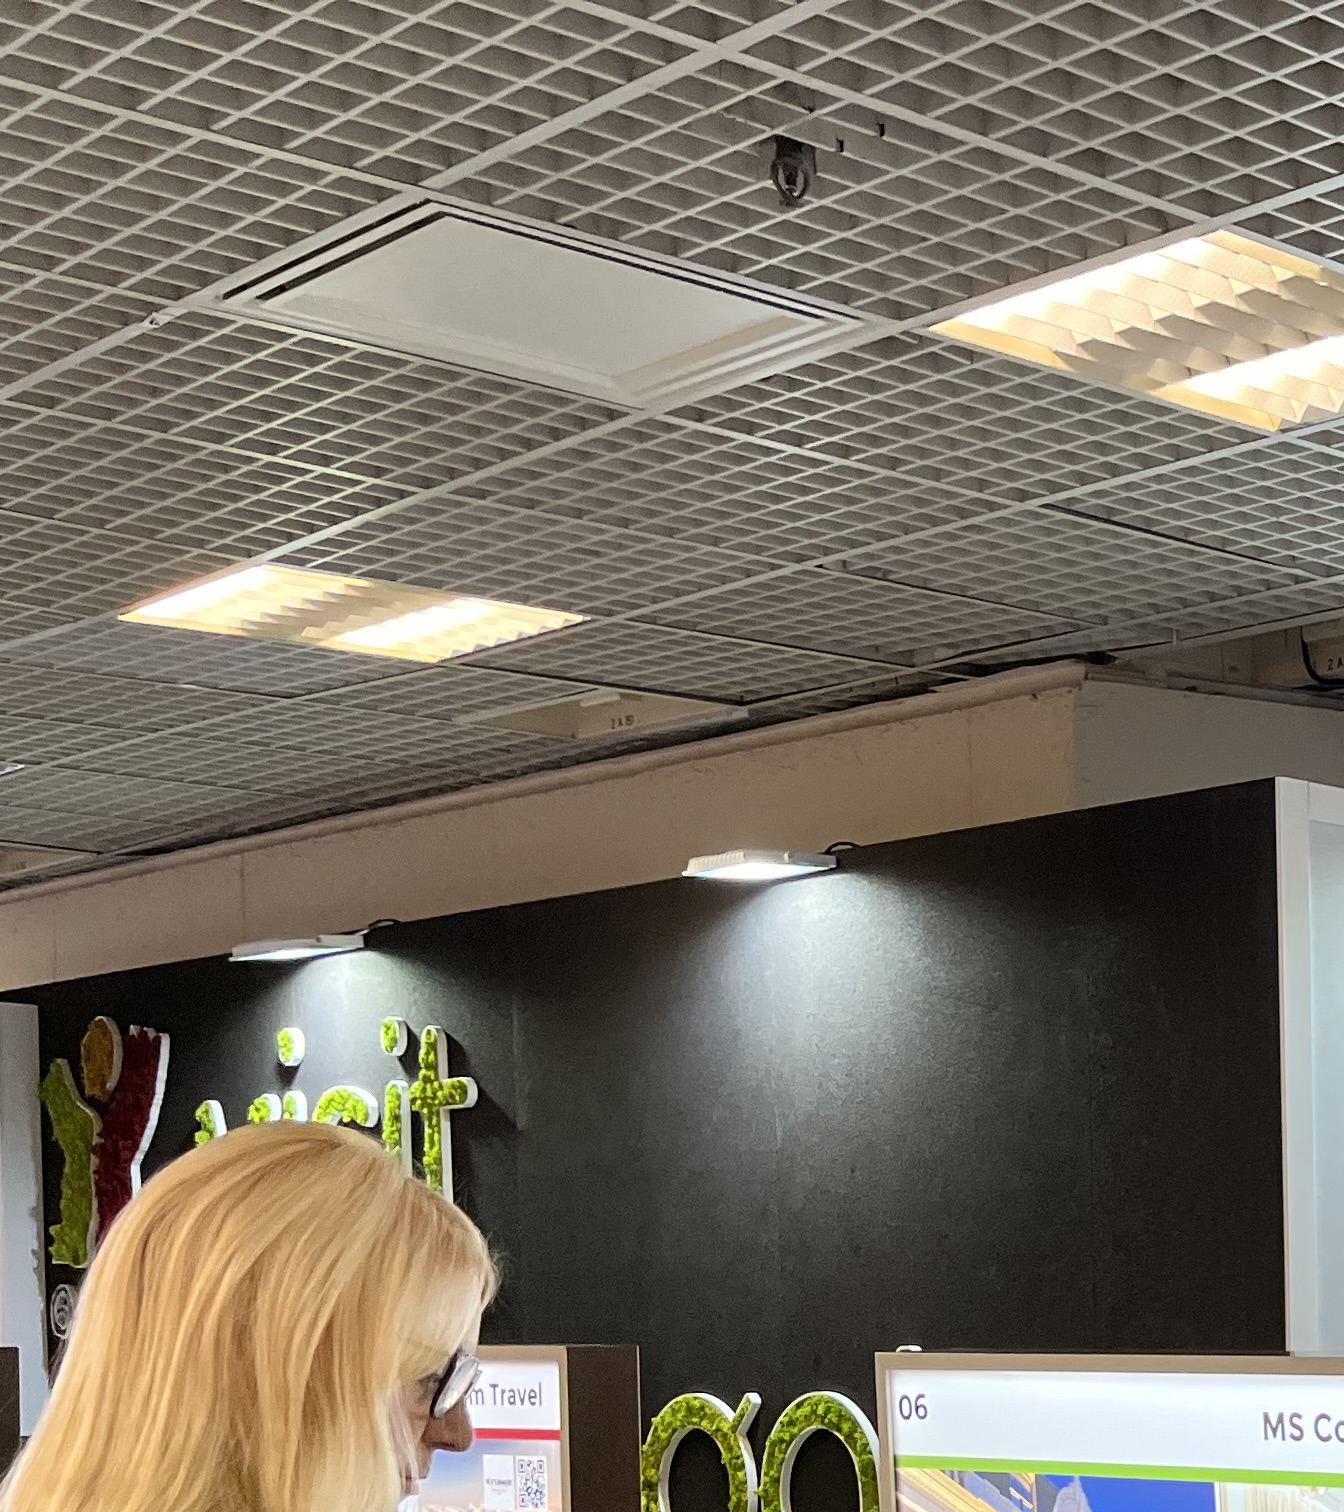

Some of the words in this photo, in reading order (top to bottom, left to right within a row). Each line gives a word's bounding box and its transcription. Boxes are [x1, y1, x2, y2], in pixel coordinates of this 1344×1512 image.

[1327, 658, 1334, 671] 2
[1337, 656, 1344, 669] A
[489, 1382, 542, 1407] Travel
[898, 1393, 928, 1421] 06
[1262, 1411, 1305, 1442] MS
